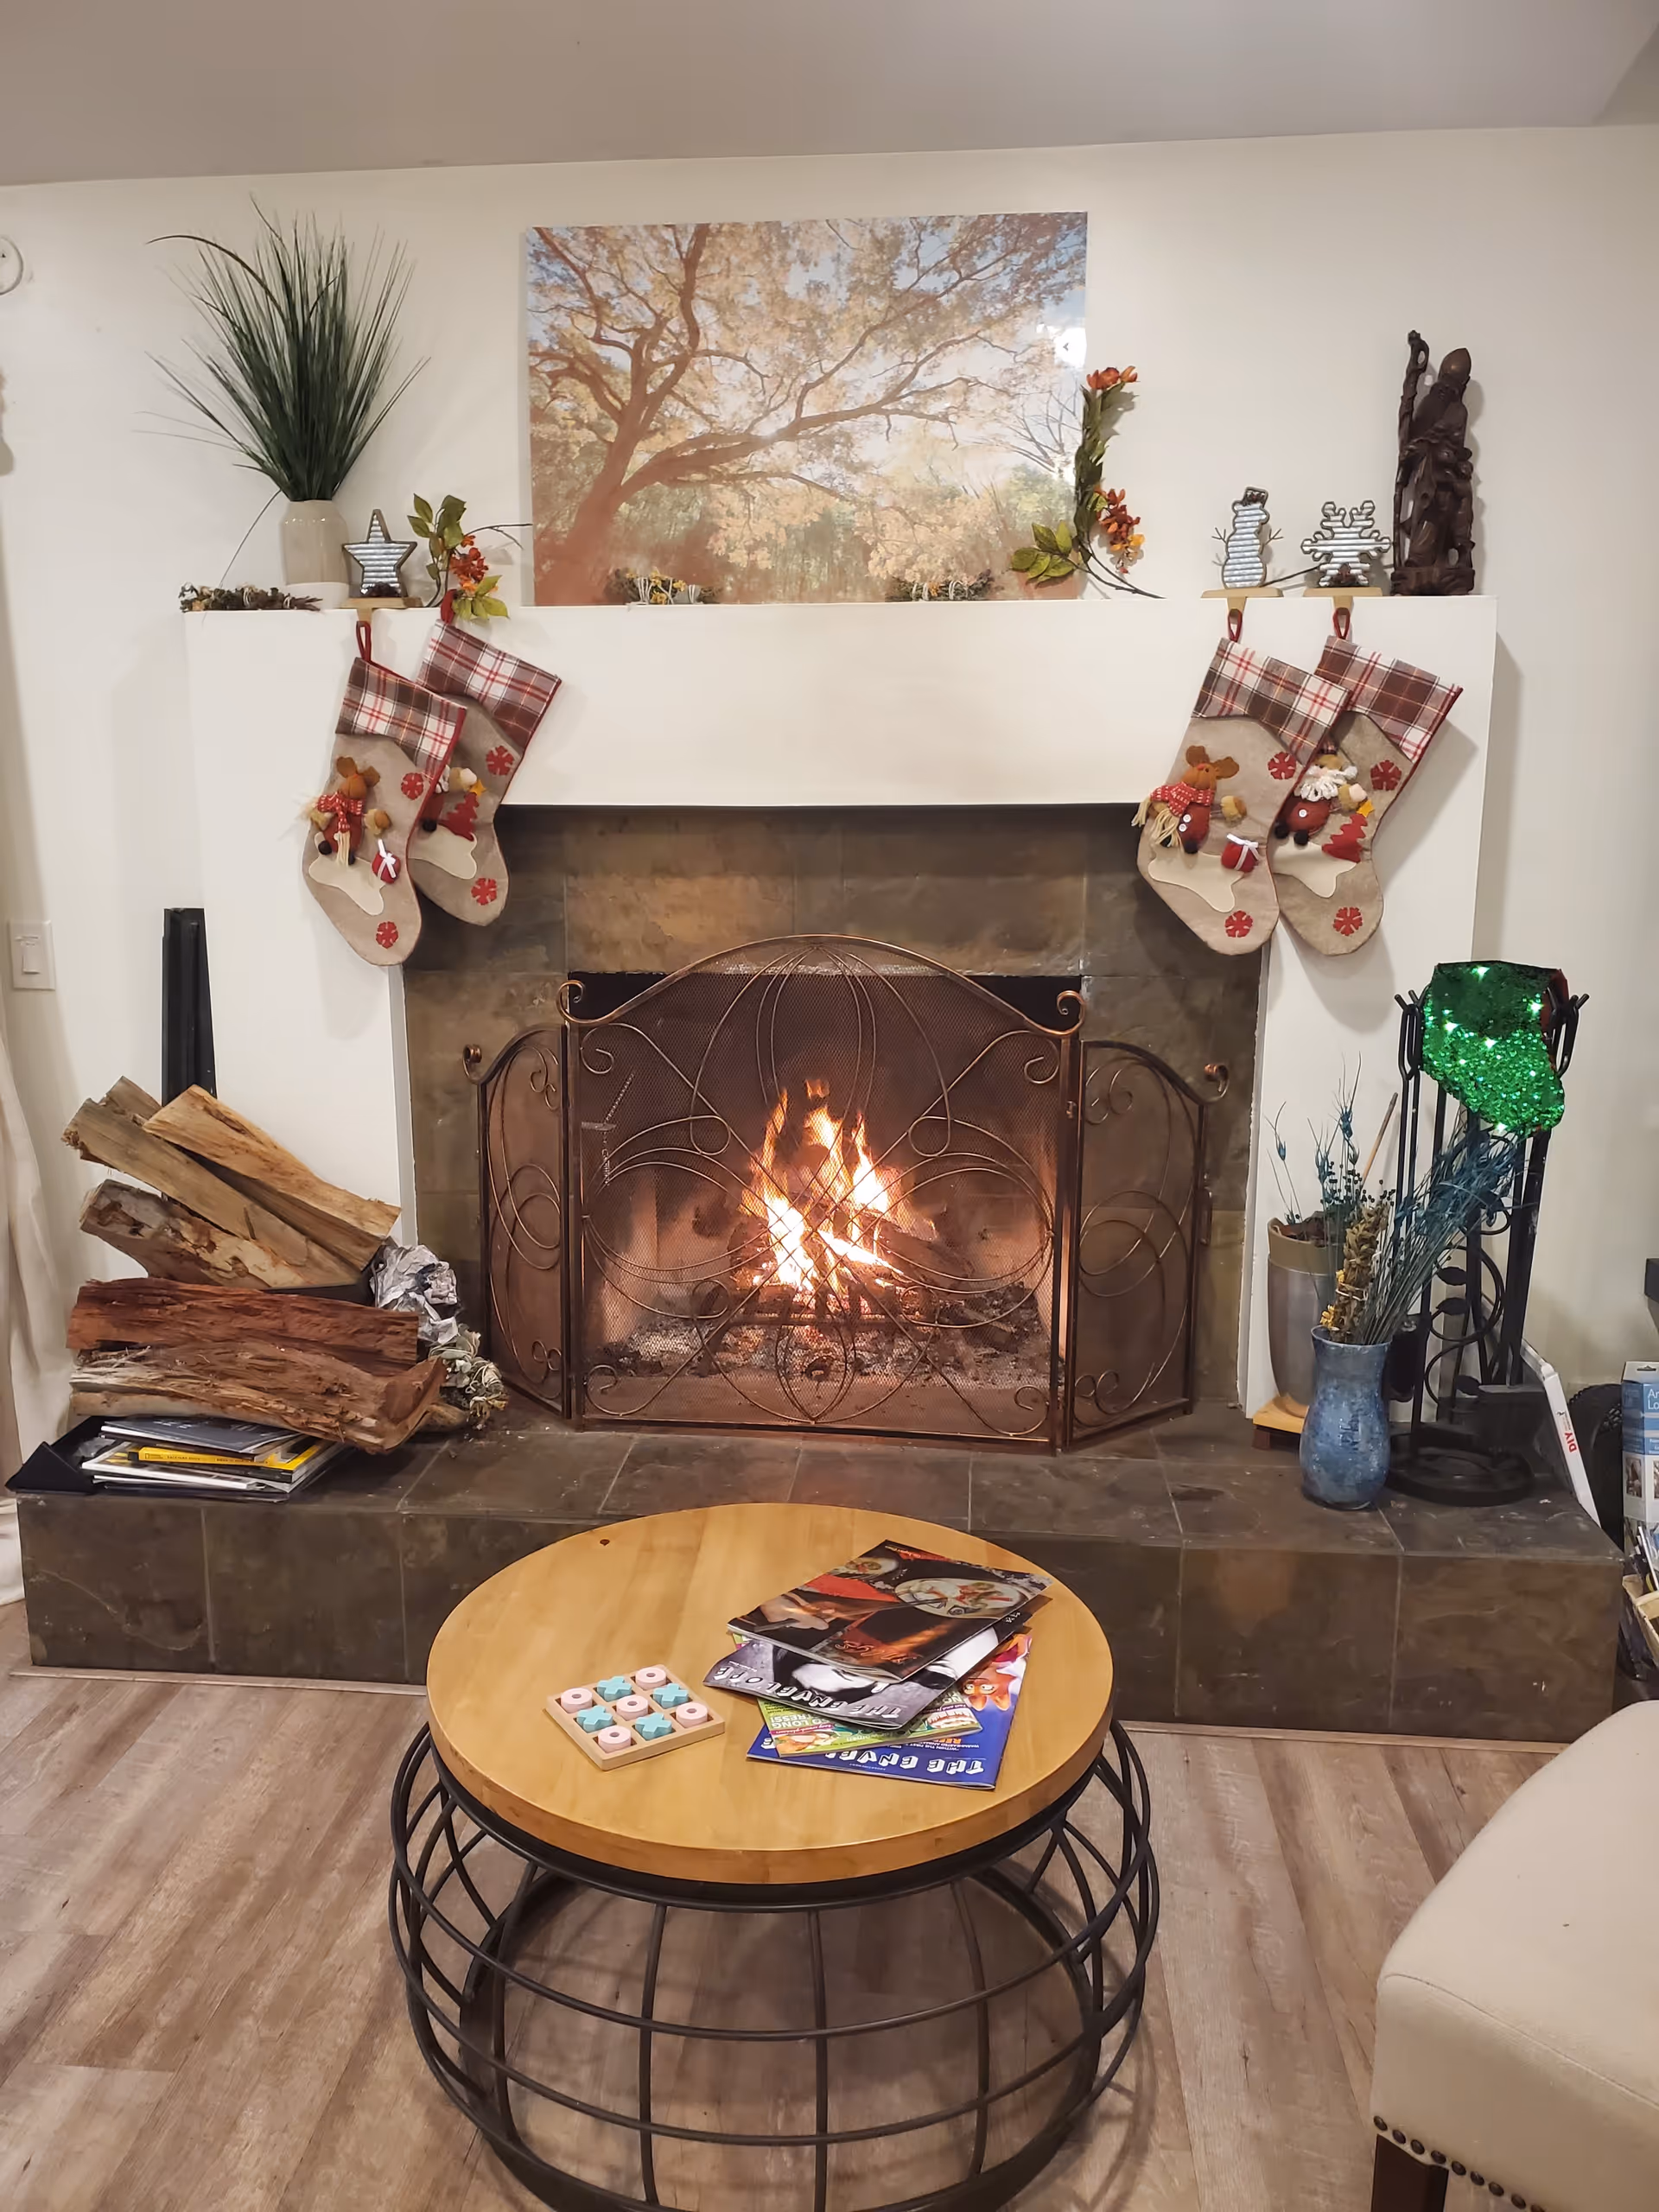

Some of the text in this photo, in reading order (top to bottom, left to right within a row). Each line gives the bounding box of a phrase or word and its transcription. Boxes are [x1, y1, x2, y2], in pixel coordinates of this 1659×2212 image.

[1564, 1432, 1578, 1453] DIY
[713, 1666, 902, 1719] THE ENVELOPE
[770, 1713, 813, 1723] TRESS!
[771, 1719, 810, 1729] LONG
[926, 1758, 984, 1775] THE
